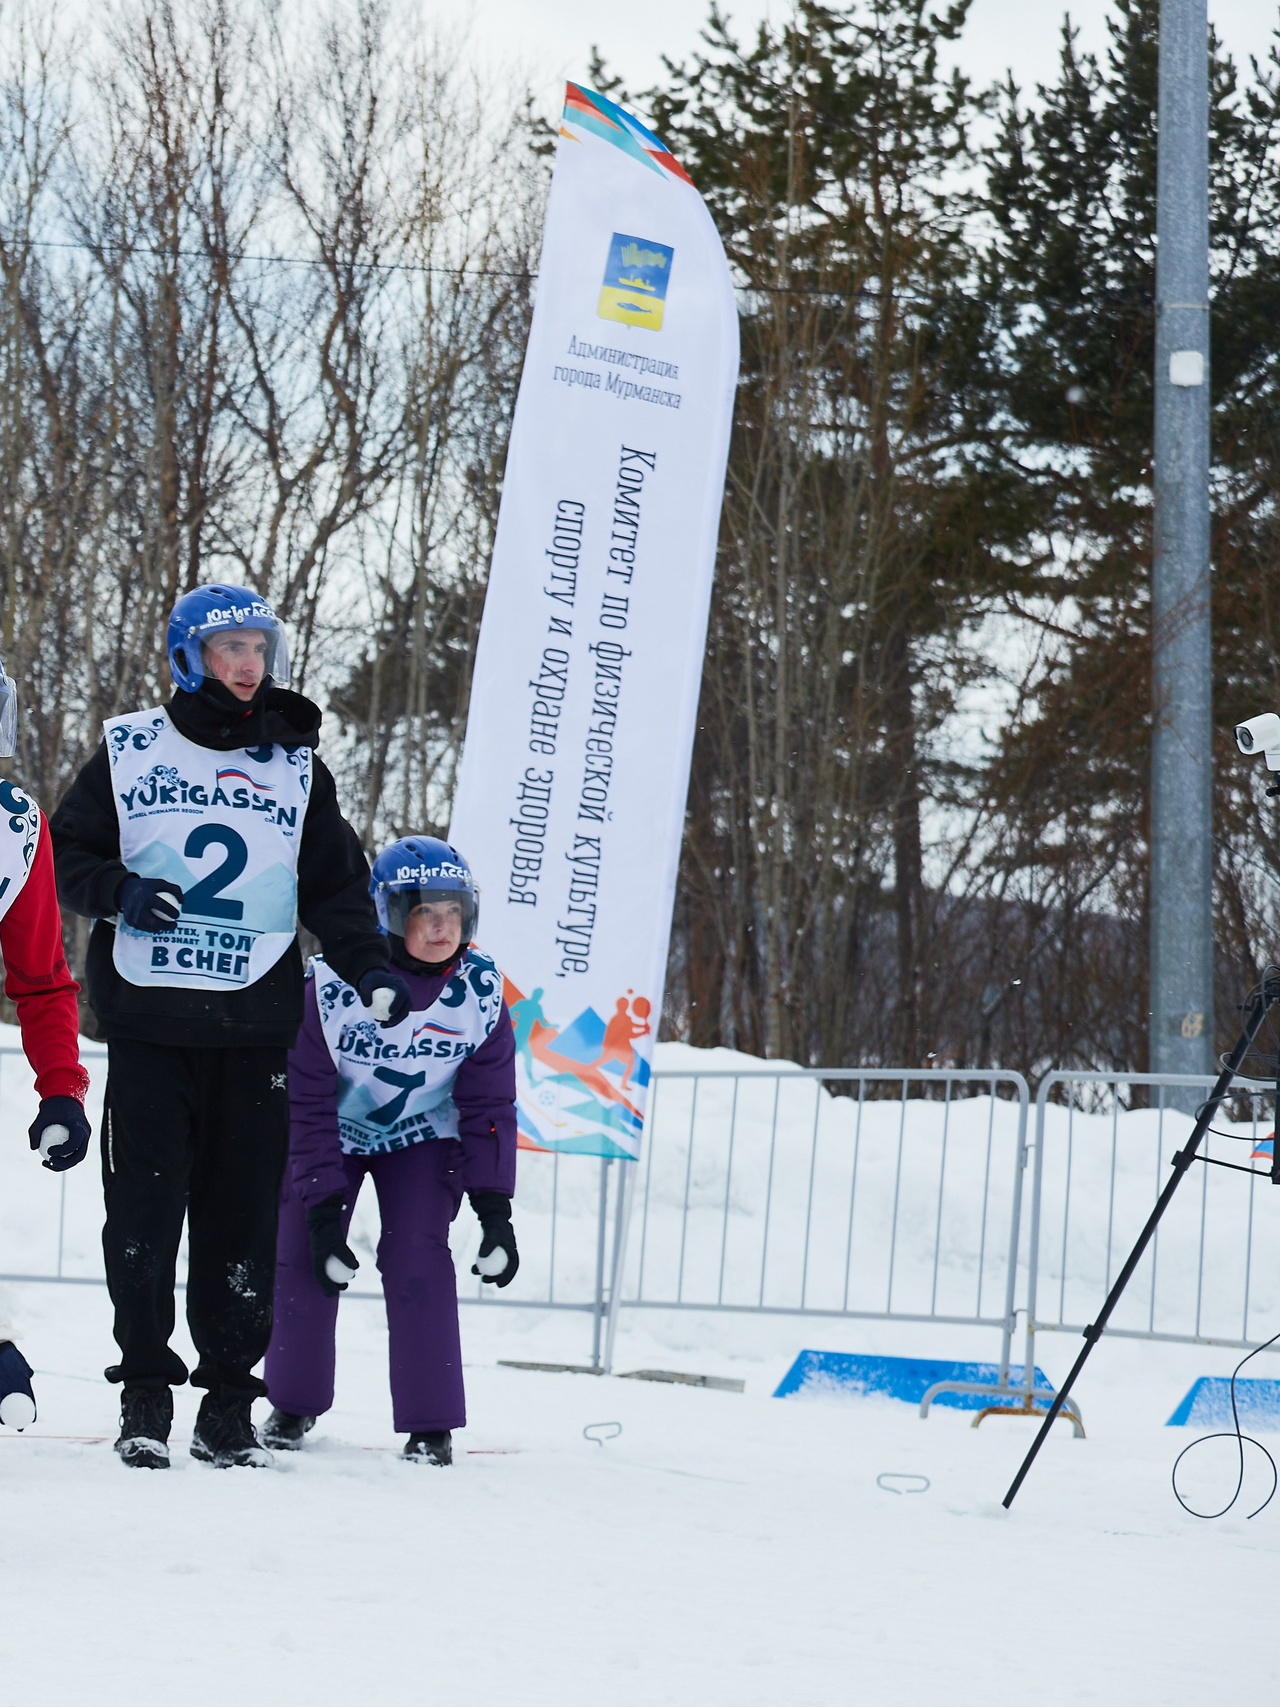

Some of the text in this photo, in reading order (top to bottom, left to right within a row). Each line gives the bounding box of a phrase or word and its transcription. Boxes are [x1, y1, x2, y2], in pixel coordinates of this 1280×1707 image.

[567, 334, 679, 380] Администрация
[552, 365, 682, 410] города Мурманска
[507, 499, 586, 907] спорту и охране здоровья
[555, 443, 657, 979] Комитет по физической культуре,
[181, 823, 249, 921] 2
[171, 937, 200, 945] ЗНАЕТ
[177, 927, 200, 938] ТЕХ,
[151, 946, 169, 967] В
[364, 1065, 426, 1127] 7
